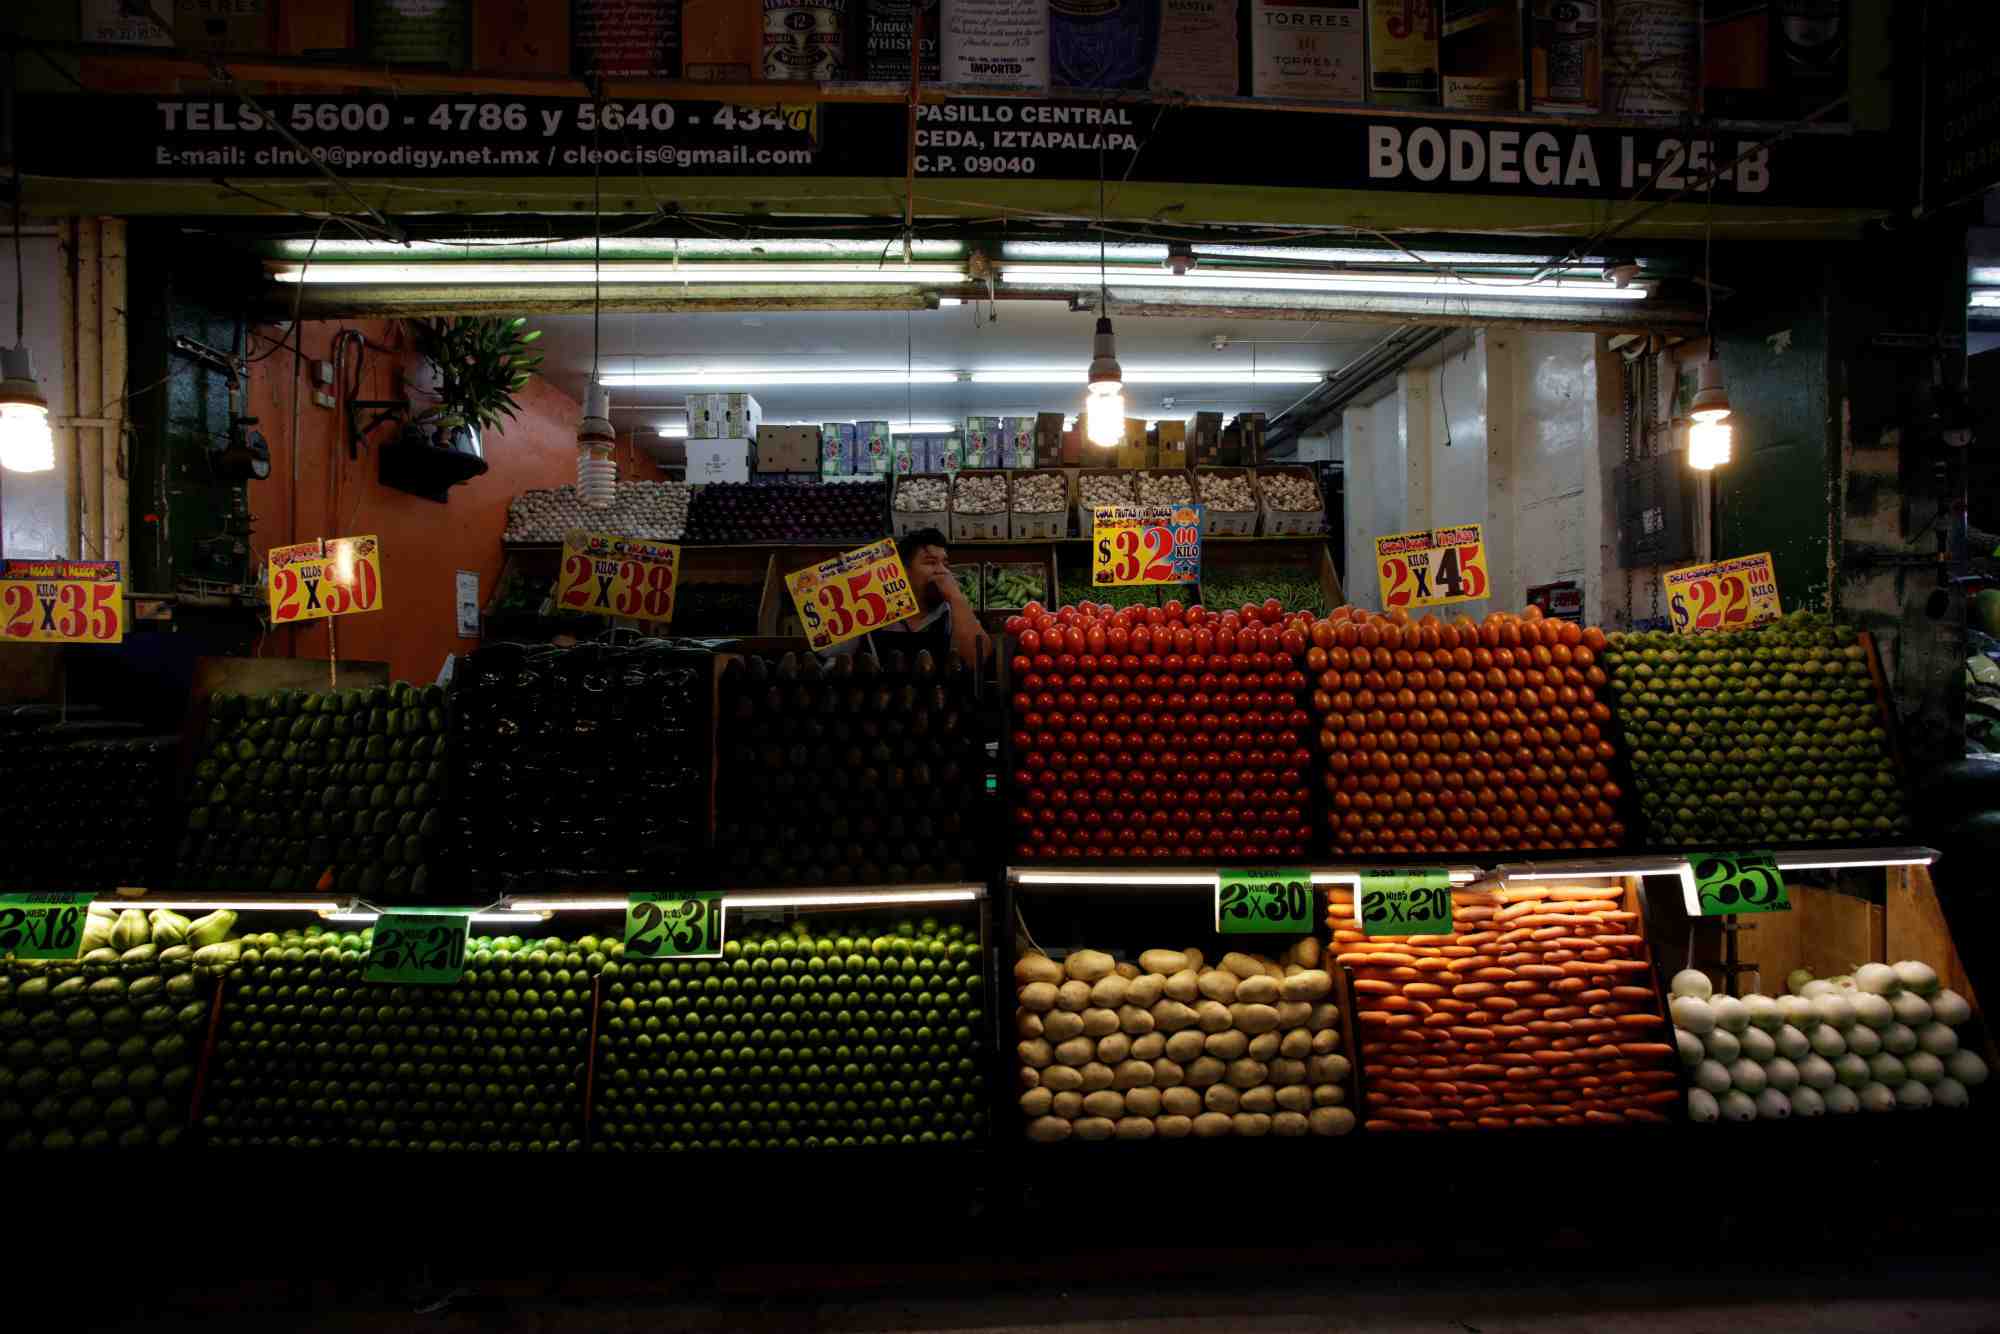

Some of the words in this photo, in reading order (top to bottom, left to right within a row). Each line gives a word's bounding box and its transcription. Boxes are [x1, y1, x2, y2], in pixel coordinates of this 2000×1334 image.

[1264, 12, 1353, 27] TORRES
[970, 63, 1022, 74] IMPORTED
[155, 103, 276, 131] TELS:
[291, 103, 390, 131] 5600
[427, 103, 527, 131] 4786
[540, 108, 564, 136] y
[575, 103, 676, 131] 5640
[915, 105, 1014, 124] PASILLO
[1019, 106, 1134, 126] CENTRAL
[914, 129, 985, 151] CEDA,
[992, 130, 1137, 151] IZTAPALAPA
[155, 145, 246, 166] E-mail:
[562, 145, 813, 169] cleocis@gmail.com
[914, 155, 957, 174] C.P.
[963, 156, 1036, 175] 09040
[1367, 124, 1600, 187] BODEGA
[1176, 546, 1200, 558] KILO
[300, 565, 322, 579] KILOS
[594, 560, 619, 576] KILOS
[882, 578, 907, 596] KILO
[1751, 583, 1775, 597] KILO
[1695, 858, 1779, 911] 25
